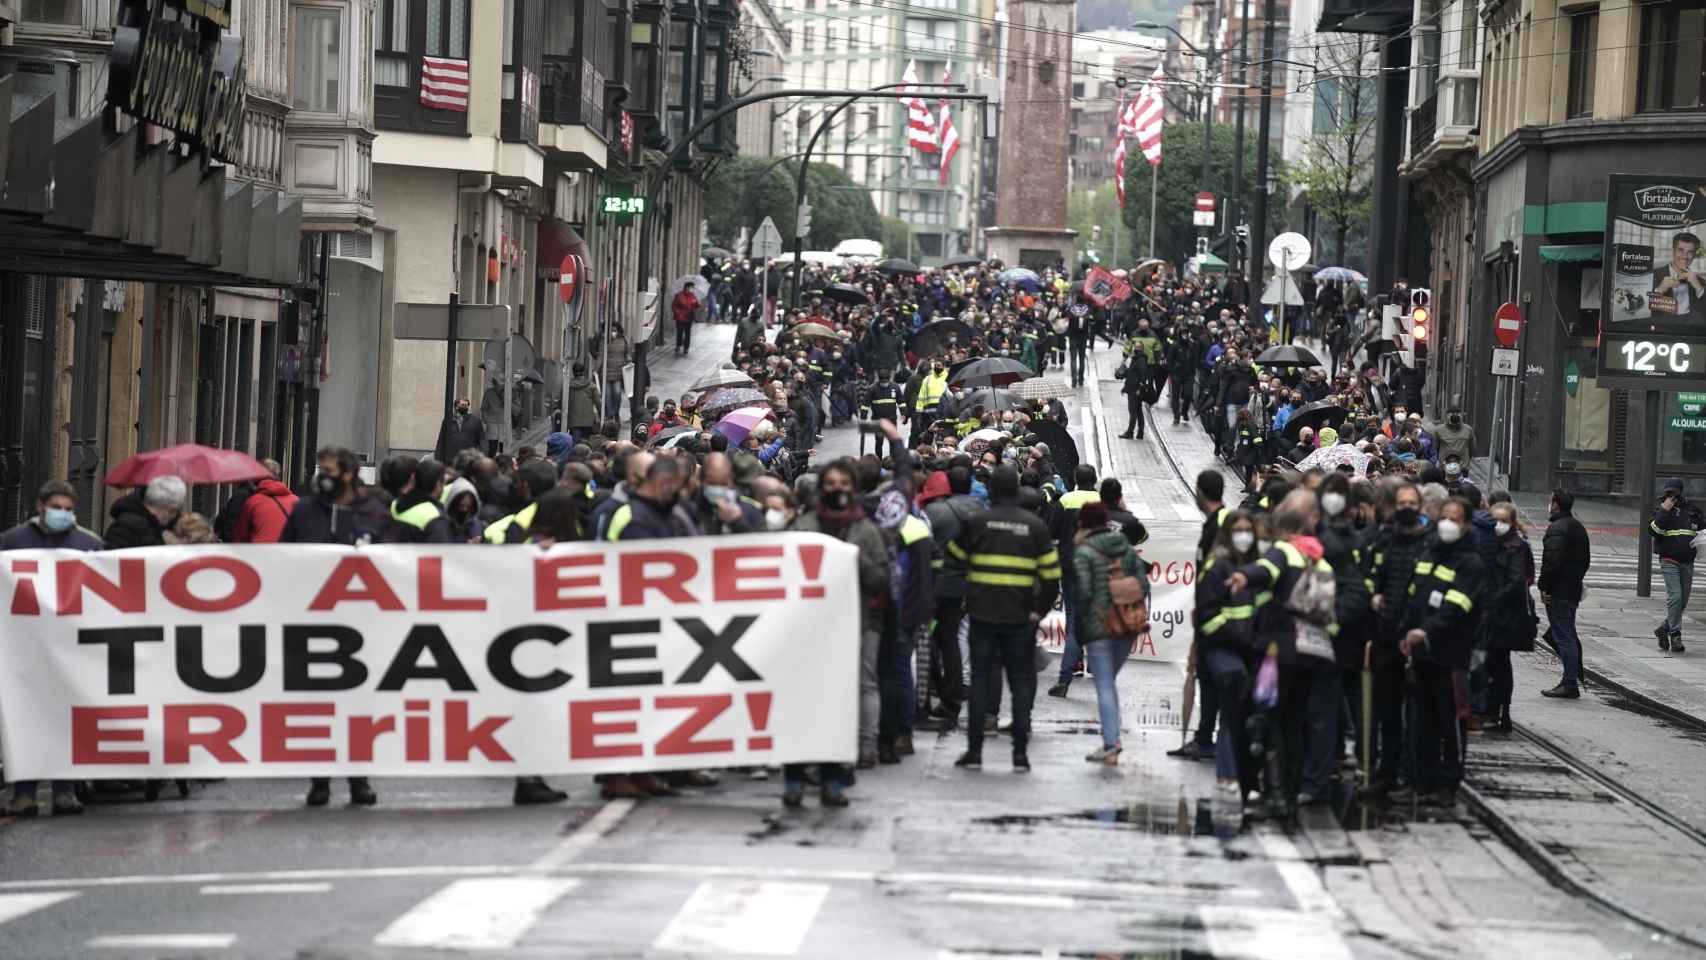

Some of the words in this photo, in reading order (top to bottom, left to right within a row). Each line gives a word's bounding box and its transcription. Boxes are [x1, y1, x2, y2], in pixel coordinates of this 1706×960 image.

[604, 197, 644, 213] 12:19
[1642, 191, 1687, 206] fortaleza
[1621, 340, 1690, 373] 12°C
[11, 555, 261, 616] ¡NO
[308, 555, 488, 612] AL
[534, 545, 825, 612] ERE!
[78, 615, 764, 694] TUBACEX
[72, 700, 515, 765] ERErik
[569, 692, 773, 761] EZ!
